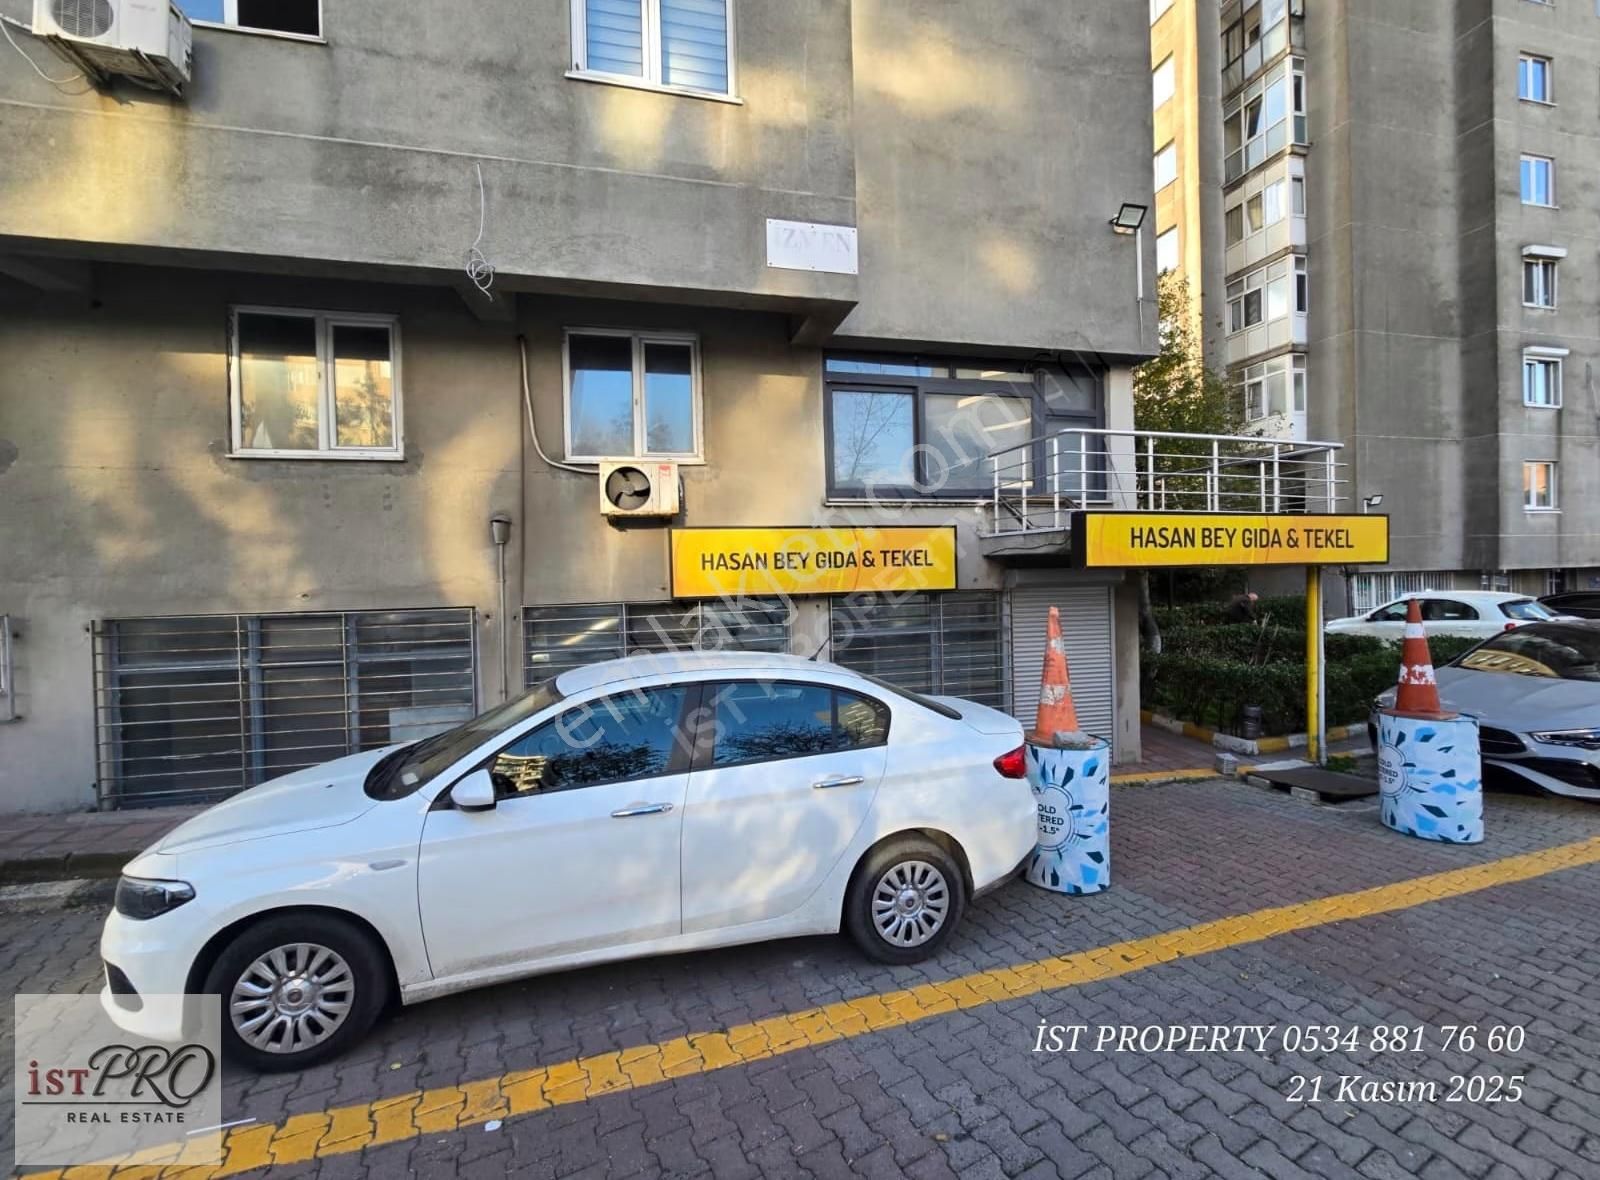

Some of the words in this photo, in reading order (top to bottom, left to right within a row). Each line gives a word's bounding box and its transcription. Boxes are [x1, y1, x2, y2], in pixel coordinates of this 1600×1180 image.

[1130, 526, 1196, 549] HASAN
[1201, 527, 1237, 548] BEY
[1242, 527, 1283, 549] GIDA
[1286, 528, 1300, 549] &
[1304, 528, 1355, 549] TEKEL
[702, 552, 769, 571] HASAN
[774, 551, 809, 570] BEY
[815, 551, 858, 569] GIDA
[862, 550, 876, 568] &
[880, 549, 934, 567] TEKEL
[1037, 803, 1057, 815] OLD
